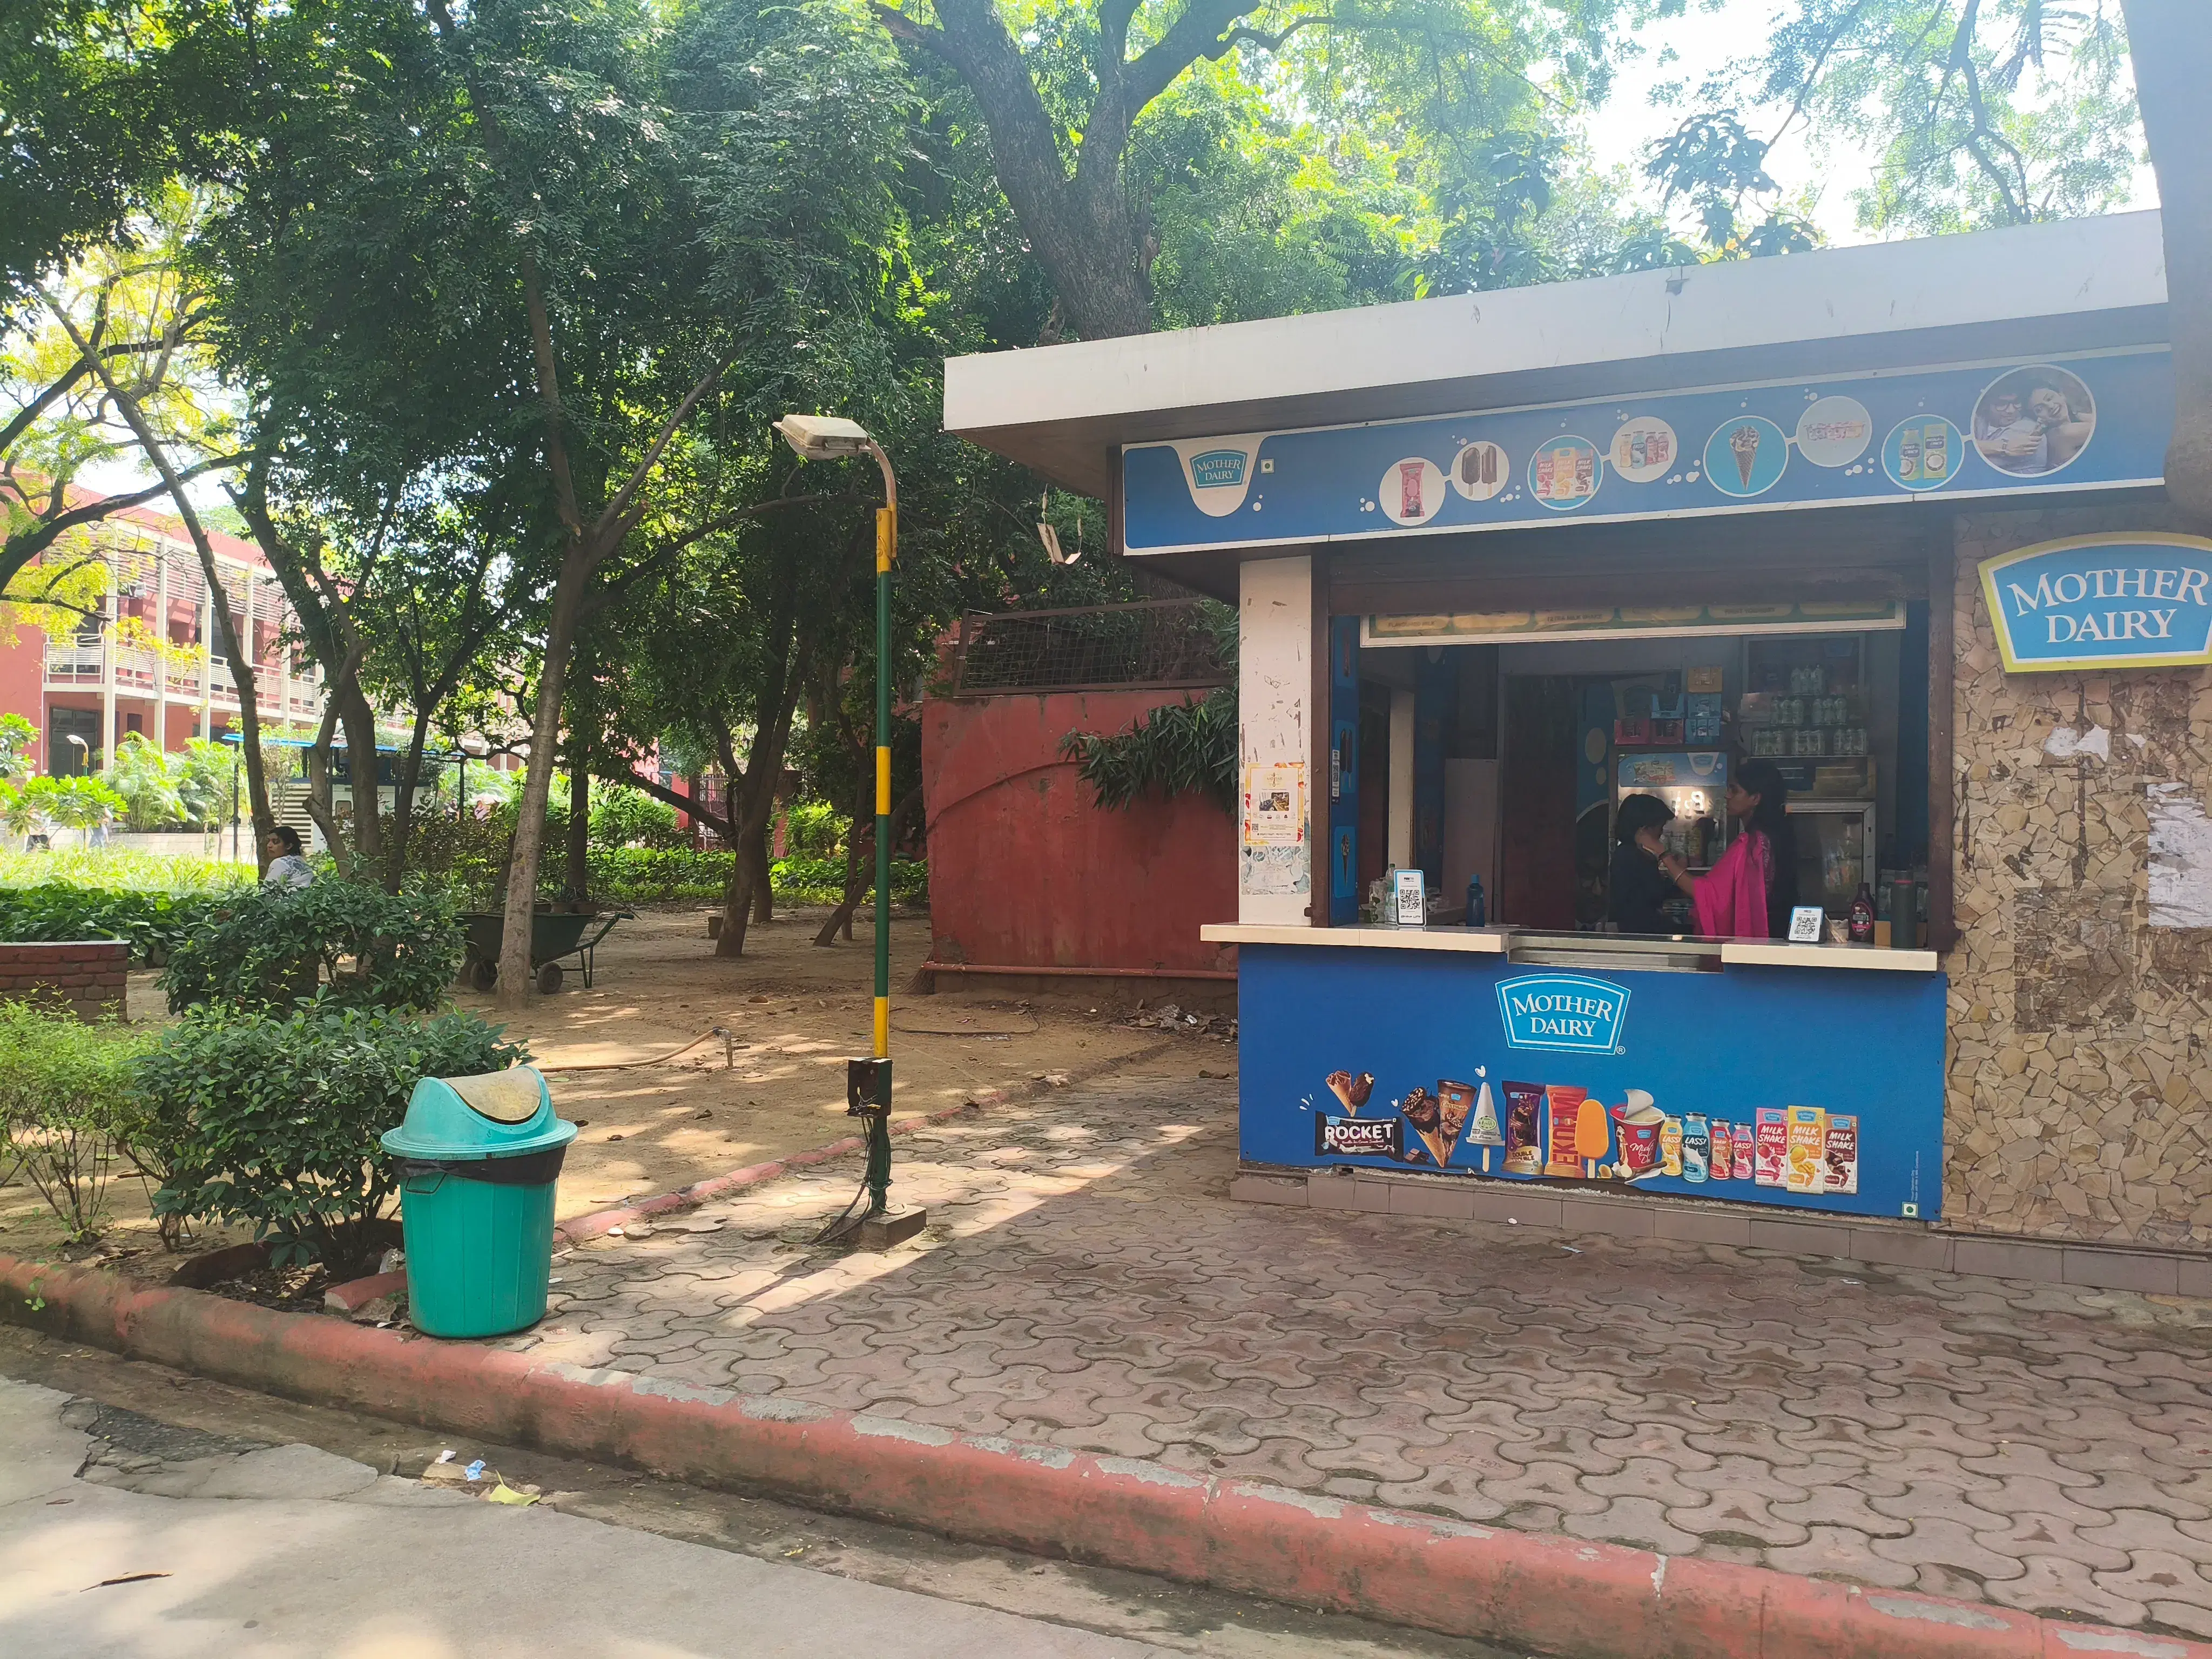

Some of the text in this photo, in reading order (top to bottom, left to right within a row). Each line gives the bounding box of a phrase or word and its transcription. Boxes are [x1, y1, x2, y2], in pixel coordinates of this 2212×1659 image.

[1196, 459, 1241, 474] MOTHER
[1205, 470, 1234, 481] DAIRY
[2006, 567, 2209, 617] MOTHER
[2044, 608, 2178, 643] DAIRY
[1511, 993, 1613, 1022] MOTHER
[1530, 1017, 1596, 1037] DAIRY
[1325, 1124, 1393, 1139] ROCKET
[1761, 1125, 1784, 1135] MILK
[1793, 1125, 1819, 1136] MILK
[1662, 1135, 1681, 1143] LASSI
[1685, 1136, 1707, 1145] LASSI
[1758, 1134, 1786, 1144] SHAKE
[1790, 1135, 1822, 1145] SHAKE
[1829, 1131, 1853, 1141] MILK
[1734, 1141, 1752, 1149] LASSI
[1826, 1140, 1855, 1150] SHAKE
